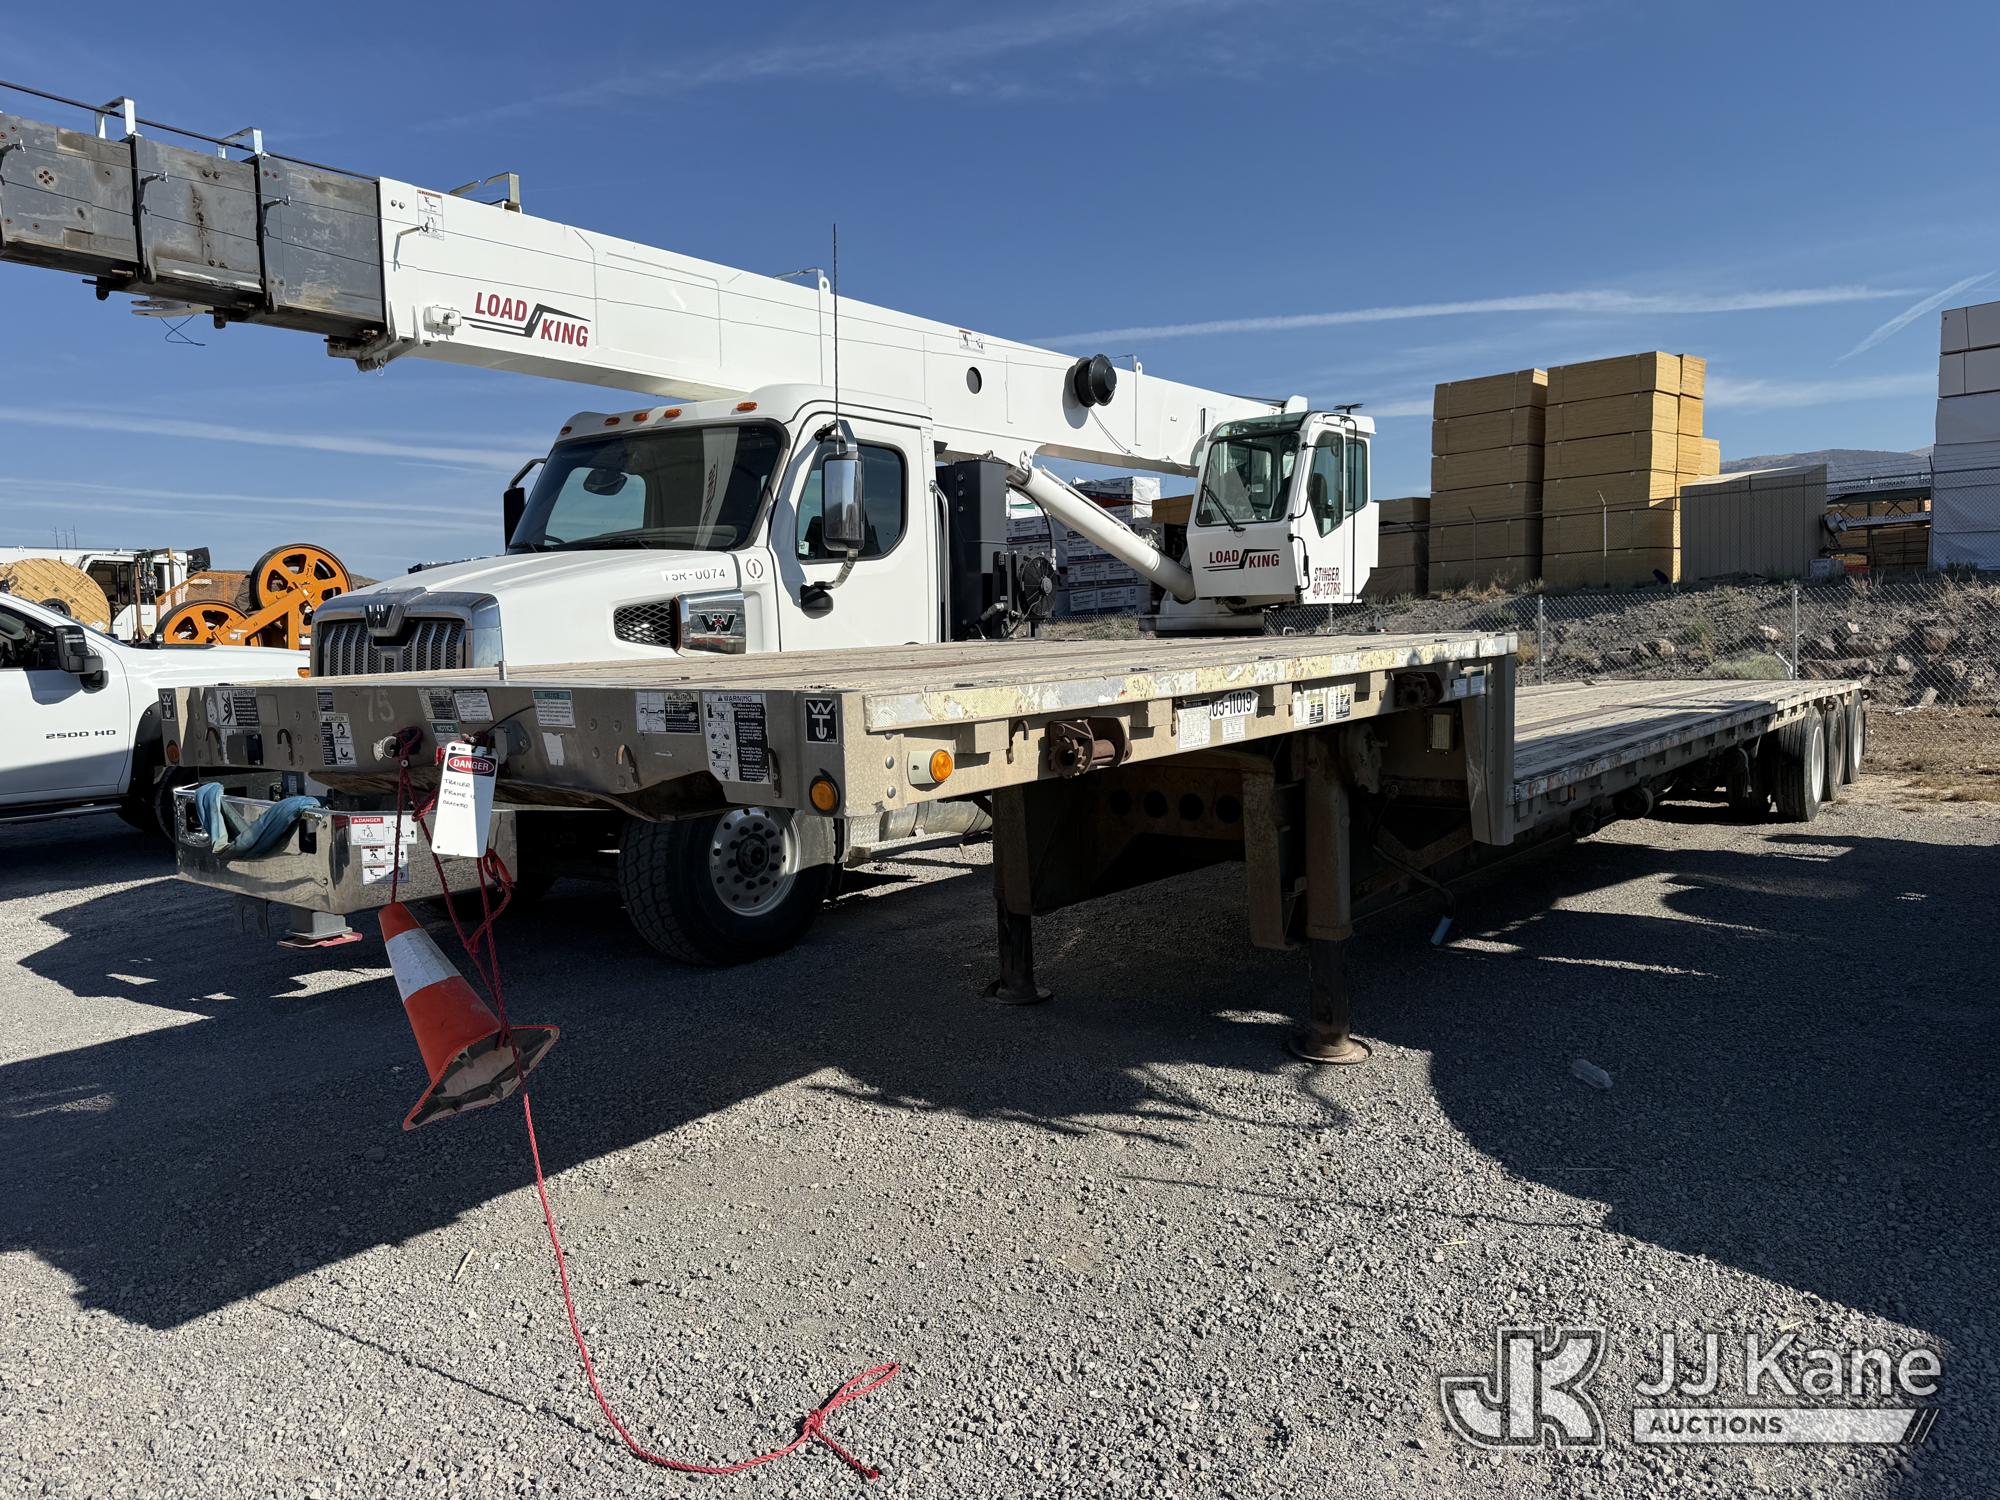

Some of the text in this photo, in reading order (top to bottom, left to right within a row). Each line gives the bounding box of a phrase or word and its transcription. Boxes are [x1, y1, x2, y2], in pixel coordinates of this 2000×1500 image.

[475, 292, 589, 347] LOAD KING
[1209, 550, 1280, 568] LOAD KING
[1314, 567, 1340, 582] STINGER
[46, 731, 89, 739] 2500
[453, 758, 489, 771] DANGER
[444, 778, 471, 788] TRAILER
[443, 789, 467, 798] FRAME
